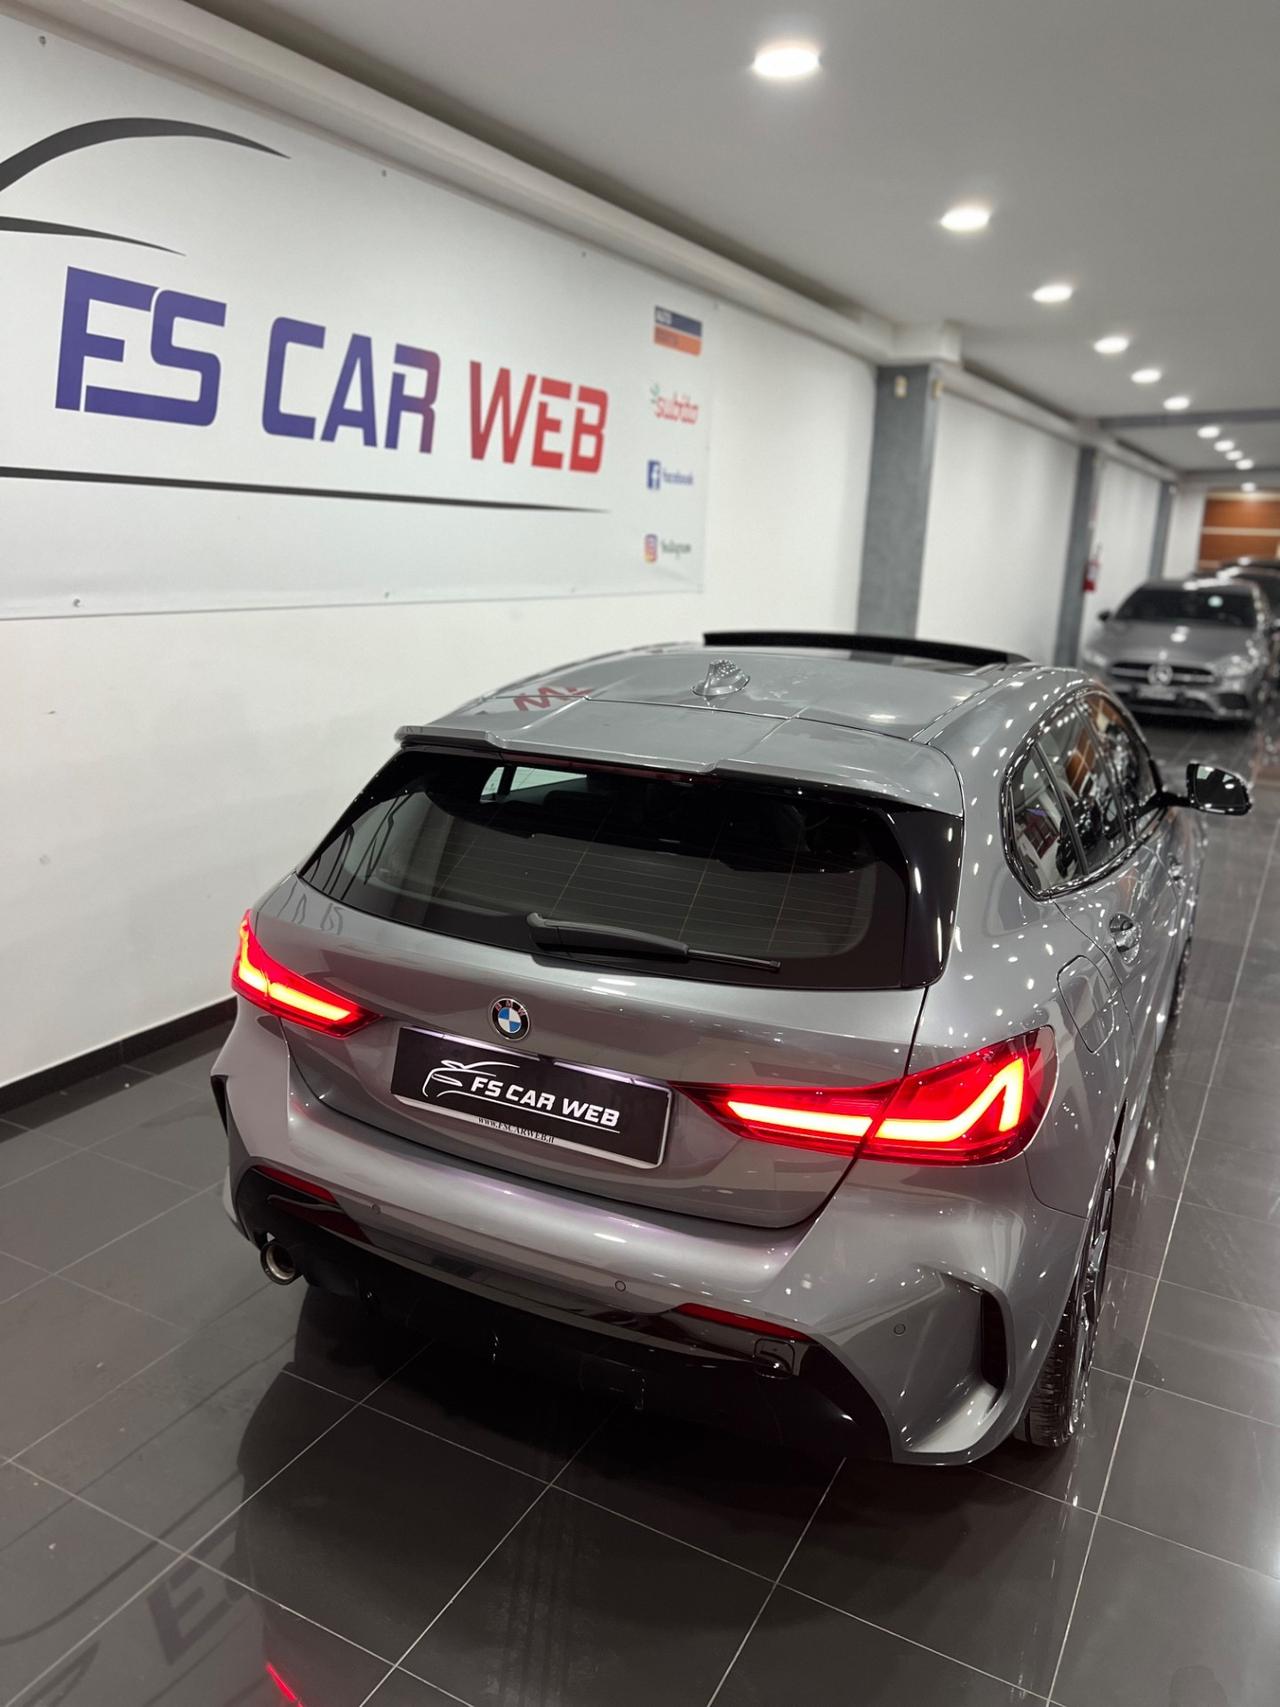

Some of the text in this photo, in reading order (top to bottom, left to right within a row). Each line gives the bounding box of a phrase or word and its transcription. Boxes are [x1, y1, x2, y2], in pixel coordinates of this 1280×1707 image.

[261, 316, 441, 454] CAR
[469, 360, 608, 474] WEB
[495, 999, 526, 1017] BMW
[470, 1076, 620, 1127] FS CAR WEB
